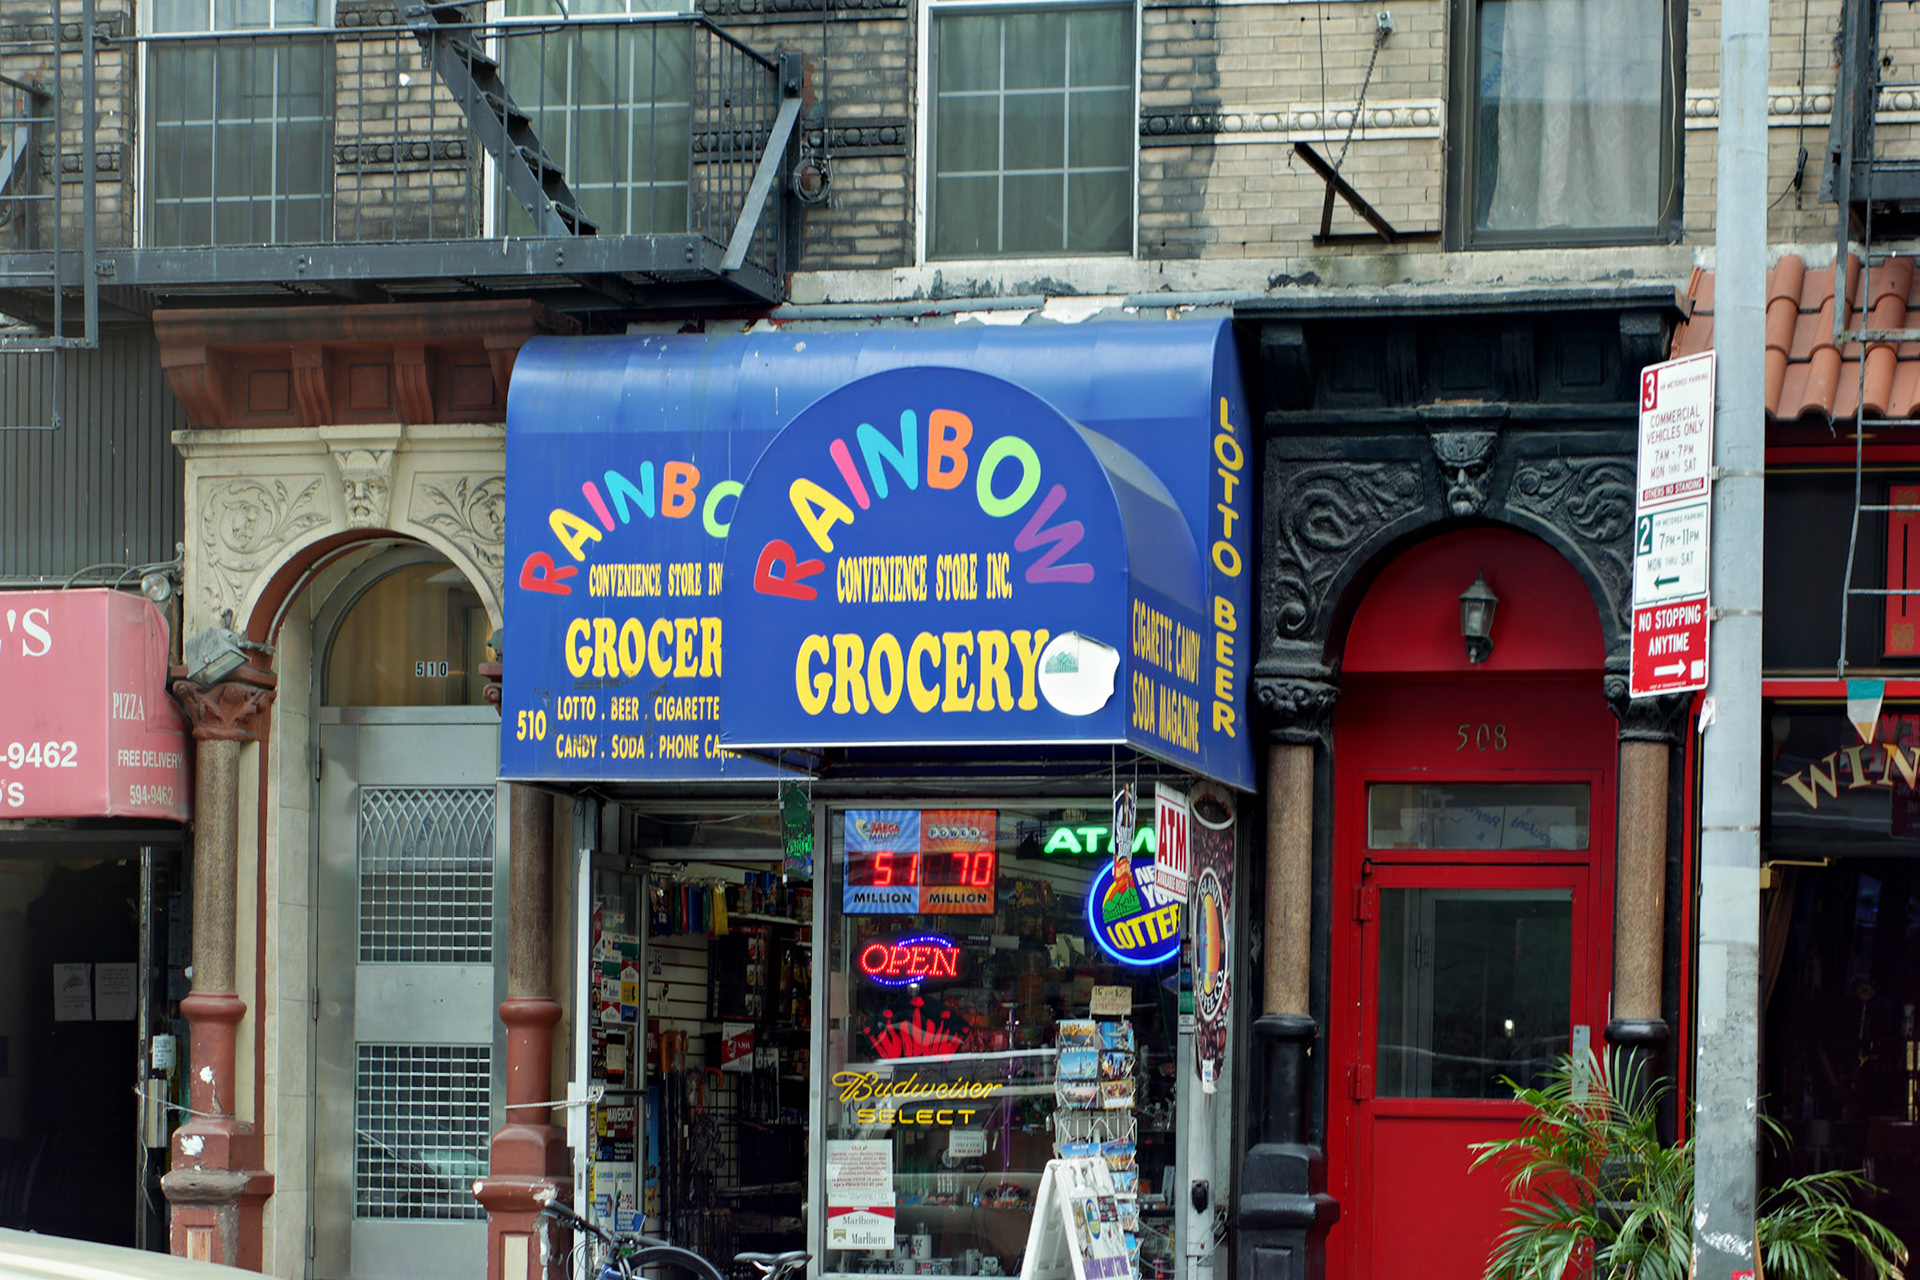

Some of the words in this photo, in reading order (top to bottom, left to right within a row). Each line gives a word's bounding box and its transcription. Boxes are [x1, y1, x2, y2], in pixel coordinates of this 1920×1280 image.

[1644, 373, 1655, 408] 3
[1650, 404, 1700, 428] COMMERCIAL
[1646, 427, 1681, 444] VEHICLES
[1684, 419, 1704, 436] ONLY
[1655, 450, 1669, 463] 7AM
[1678, 444, 1694, 457] 7PM
[1651, 466, 1664, 480] MON
[1684, 458, 1697, 473] SAT
[1212, 397, 1244, 578] LOTTO
[1645, 487, 1664, 500] OTHERS
[1666, 484, 1674, 495] NO
[1675, 479, 1702, 494] STANDING
[754, 409, 1094, 600] RAINBOW
[519, 461, 744, 595] RAINBO
[1639, 517, 1650, 553] 2
[1684, 511, 1704, 523] PARKING
[1660, 532, 1675, 550] 7PM
[1682, 529, 1699, 546] 11PM
[1647, 557, 1661, 571] MON
[1681, 551, 1693, 566] SAT
[589, 563, 662, 597] CONVENIENCE
[668, 562, 702, 596] STORE
[836, 555, 928, 603] CONVENIENCE
[936, 553, 978, 601] STORE
[986, 551, 1013, 599] INC.
[0, 607, 53, 658] 'S
[1638, 612, 1651, 633] NO
[1655, 604, 1702, 630] STOPPING
[565, 617, 722, 679] GROCER
[1132, 598, 1173, 674] CIGARETTE
[1175, 621, 1201, 686] CANDY
[1648, 632, 1690, 656] ANYTIME
[416, 662, 448, 677] 510
[795, 629, 1050, 715] GROCERY
[1213, 595, 1237, 738] BEER
[112, 692, 145, 721] PIZZA
[557, 696, 596, 720] LOTTO
[611, 697, 639, 721] BEER
[1132, 669, 1155, 736] SODA
[1159, 681, 1199, 754] MAGAZINE
[516, 709, 547, 741] 510
[1455, 723, 1507, 751] 508
[118, 750, 141, 767] FREE
[142, 750, 183, 769] DELIVERY
[556, 734, 597, 759] CANDY
[611, 734, 645, 759] SODA
[659, 734, 699, 759] PHONE
[129, 784, 174, 806] 594-9462
[1158, 804, 1187, 874] ATM
[873, 851, 918, 886] 51
[952, 851, 993, 886] 70
[854, 893, 912, 903] MILLION
[928, 893, 987, 903] MILLION
[1107, 903, 1181, 949] LOTTER
[861, 943, 960, 977] OPEN
[832, 1071, 1003, 1102] Budweiser
[607, 1107, 634, 1122] MAVERICK
[857, 1108, 976, 1125] SELECT
[842, 1216, 879, 1225] Marlboro
[851, 1232, 886, 1245] Marlboro
